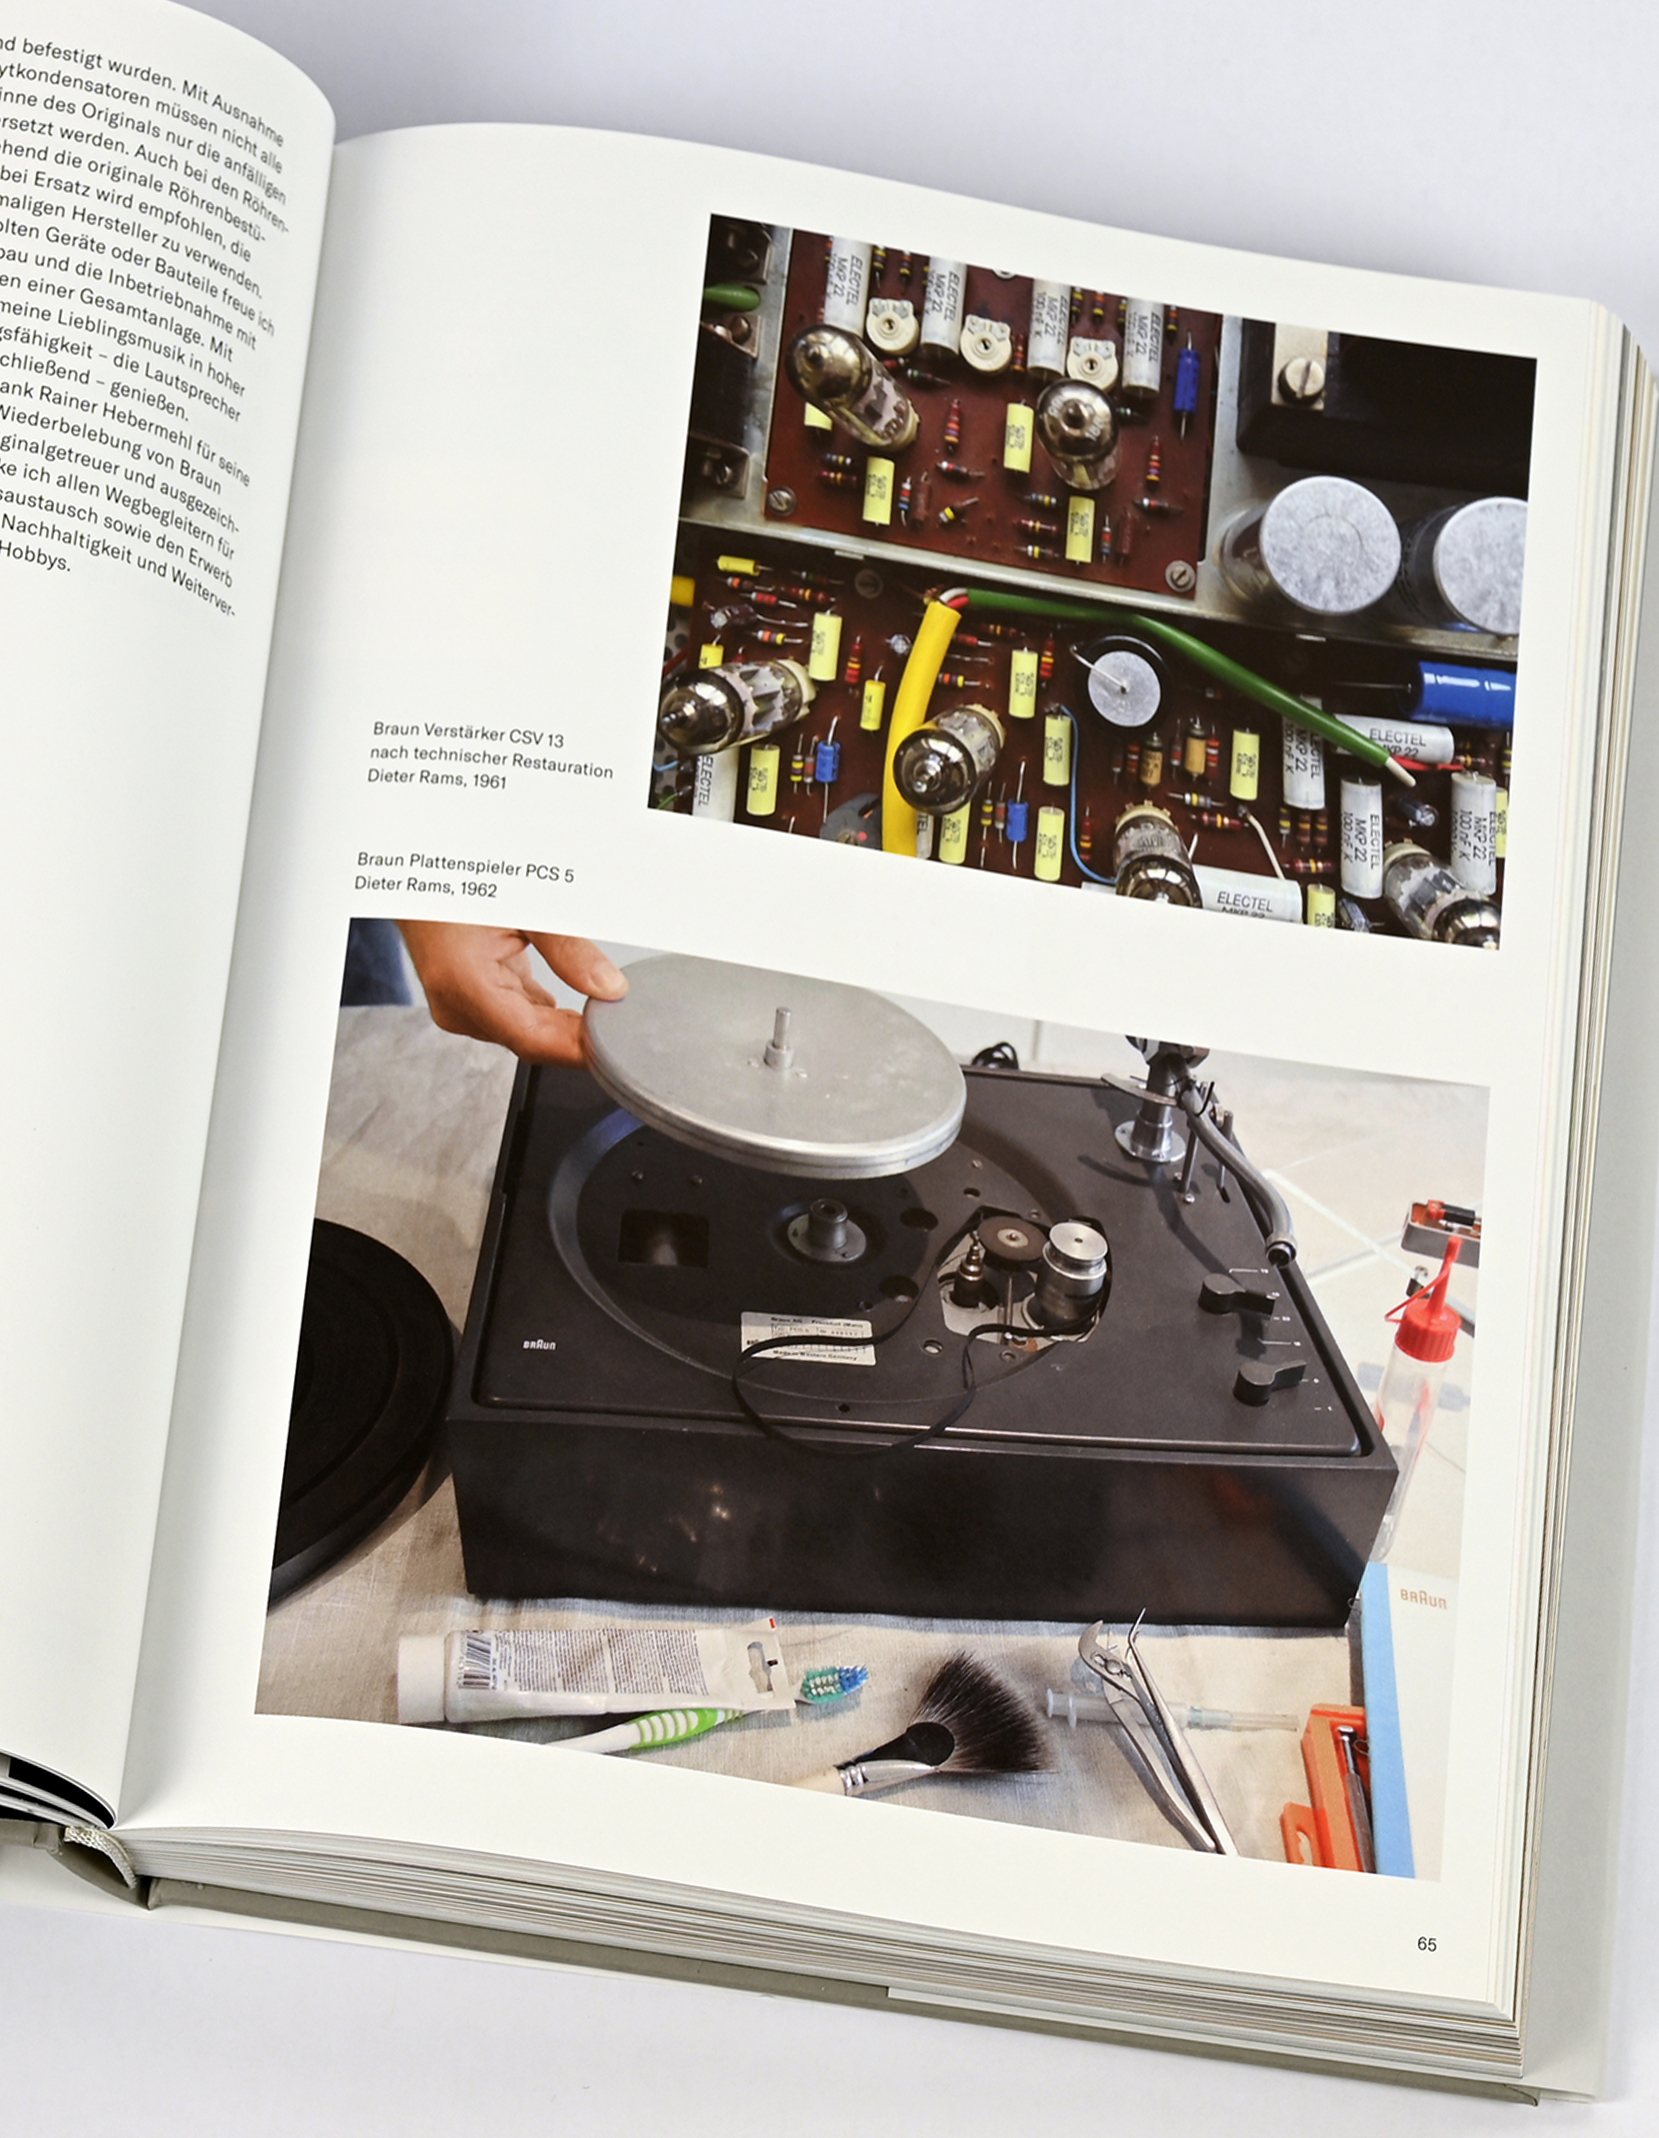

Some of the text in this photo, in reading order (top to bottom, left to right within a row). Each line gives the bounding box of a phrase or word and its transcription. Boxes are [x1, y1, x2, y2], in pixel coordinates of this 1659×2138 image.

[22, 38, 103, 71] befestigt
[107, 60, 177, 92] wurden.
[181, 80, 209, 105] Mit
[211, 94, 284, 148] Ausnahme
[42, 95, 77, 115] des
[81, 102, 161, 139] Originals
[165, 131, 195, 151] nur
[196, 142, 221, 163] die
[223, 157, 286, 205] anfälligen
[155, 101, 218, 135] müssen
[221, 129, 258, 158] nicht
[259, 151, 283, 175] alle
[53, 150, 83, 169] die
[87, 160, 164, 193] originale
[167, 182, 266, 241] Röhrenbestü-
[59, 127, 130, 156] werden.
[133, 144, 179, 172] Auch
[183, 160, 209, 184] bei
[211, 176, 239, 201] den
[241, 190, 291, 233] Röhren-
[0, 165, 251, 263] bei Ersatz wird empfohlen, die
[71, 205, 159, 244] Hersteller
[161, 236, 181, 254] zu
[184, 246, 262, 299] verwenden.
[34, 254, 71, 273] und
[74, 261, 103, 281] die
[108, 268, 234, 335] Inbetriebnahme
[235, 328, 257, 351] mit
[45, 226, 107, 255] Geräte
[111, 247, 152, 269] oder
[154, 257, 219, 299] Bauteile
[221, 288, 256, 321] freue
[257, 312, 276, 336] ich
[846, 255, 863, 306] ELECTEL
[944, 271, 960, 322] ELECTEL
[27, 278, 76, 300] einer
[79, 288, 205, 348] Gesamtanlage.
[209, 336, 233, 363] Mit
[1056, 295, 1068, 345] ELECTEL
[1148, 311, 1162, 363] ELECTEL
[57, 309, 186, 366] Lieblingsmusik
[188, 353, 203, 374] in
[206, 362, 246, 397] hoher
[0, 352, 90, 384] chließend
[109, 382, 189, 423] genießen.
[112, 352, 140, 374] die
[144, 362, 241, 422] Lautsprecher
[0, 382, 250, 487] ank Rainer Hebermehl für seine
[145, 448, 175, 471] von
[179, 459, 222, 495] Braun
[22, 463, 51, 485] ich
[55, 474, 101, 498] allen
[105, 484, 215, 548] Wegbegleitern
[217, 537, 235, 560] für
[123, 468, 157, 490] und
[159, 482, 239, 533] ausgezeich-
[0, 540, 70, 572] Hobbys.
[1, 513, 235, 616] Nachhaltigkeit und Weiterver-
[103, 516, 152, 544] sowie
[155, 534, 185, 559] den
[187, 548, 233, 589] Erwerb
[374, 721, 565, 749] Braun Verstärker CSV 13
[1369, 728, 1427, 747] ELECTEL
[367, 768, 507, 790] Dieter Rams, 1961
[370, 746, 614, 779] nach technischer Restauration
[698, 755, 714, 806] ELECTEL
[1285, 764, 1294, 775] K
[1295, 757, 1308, 772] 22
[1343, 811, 1353, 832] 100
[1370, 814, 1381, 870] ELECTEL
[1459, 809, 1472, 863] 100 nF K
[357, 852, 575, 883] Braun Plattenspieler PCS 5
[1343, 852, 1353, 864] K
[1354, 846, 1367, 863] 22
[1473, 845, 1487, 861] 22
[355, 876, 498, 899] Dieter Rams, 1962
[1217, 891, 1273, 913] ELECTEL
[1417, 1936, 1438, 1952] 65
